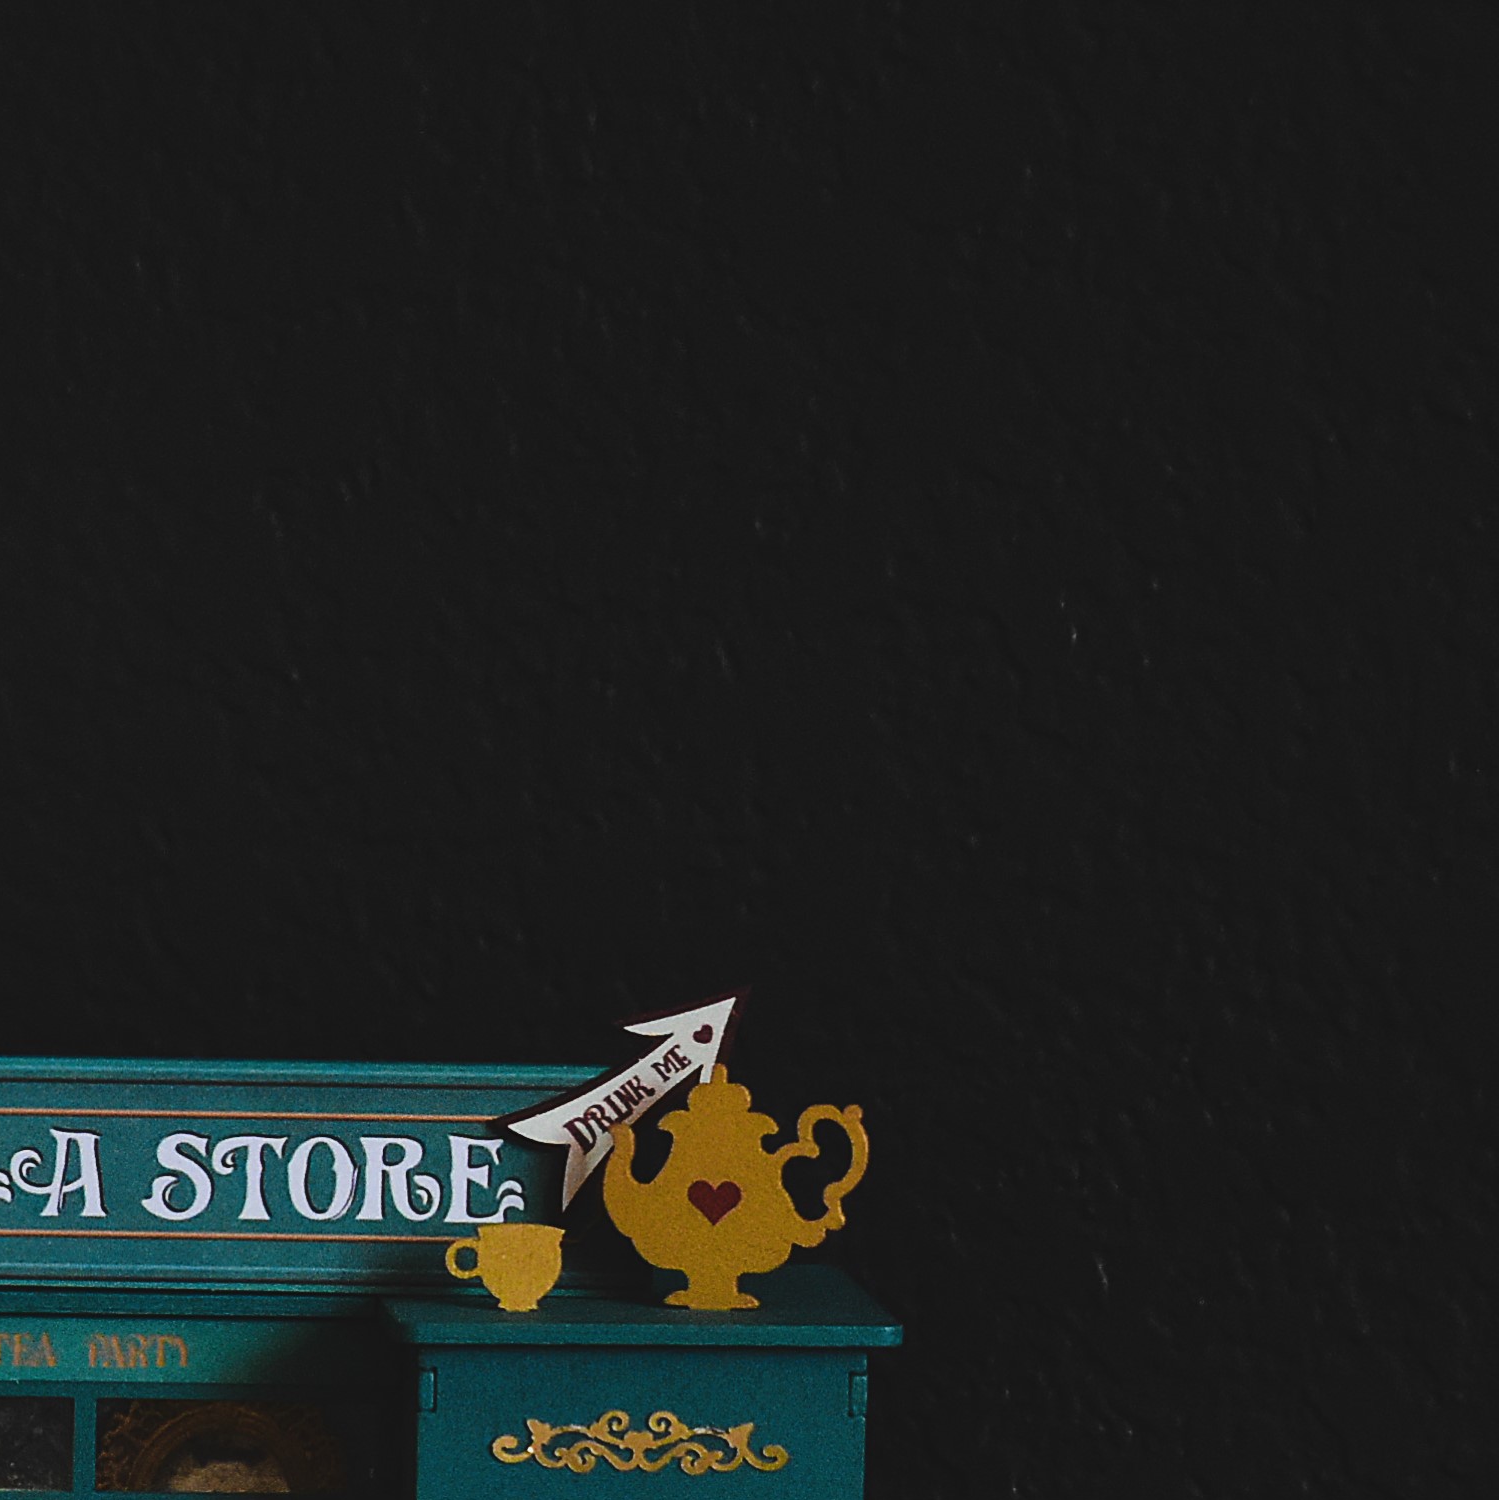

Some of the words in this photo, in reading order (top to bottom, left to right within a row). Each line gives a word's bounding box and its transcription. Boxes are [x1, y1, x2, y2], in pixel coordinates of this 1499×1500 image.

[563, 1075, 656, 1155] DRINK
[651, 1044, 692, 1082] ME
[141, 1131, 525, 1223] STORE
[88, 1334, 189, 1369] PARTY
